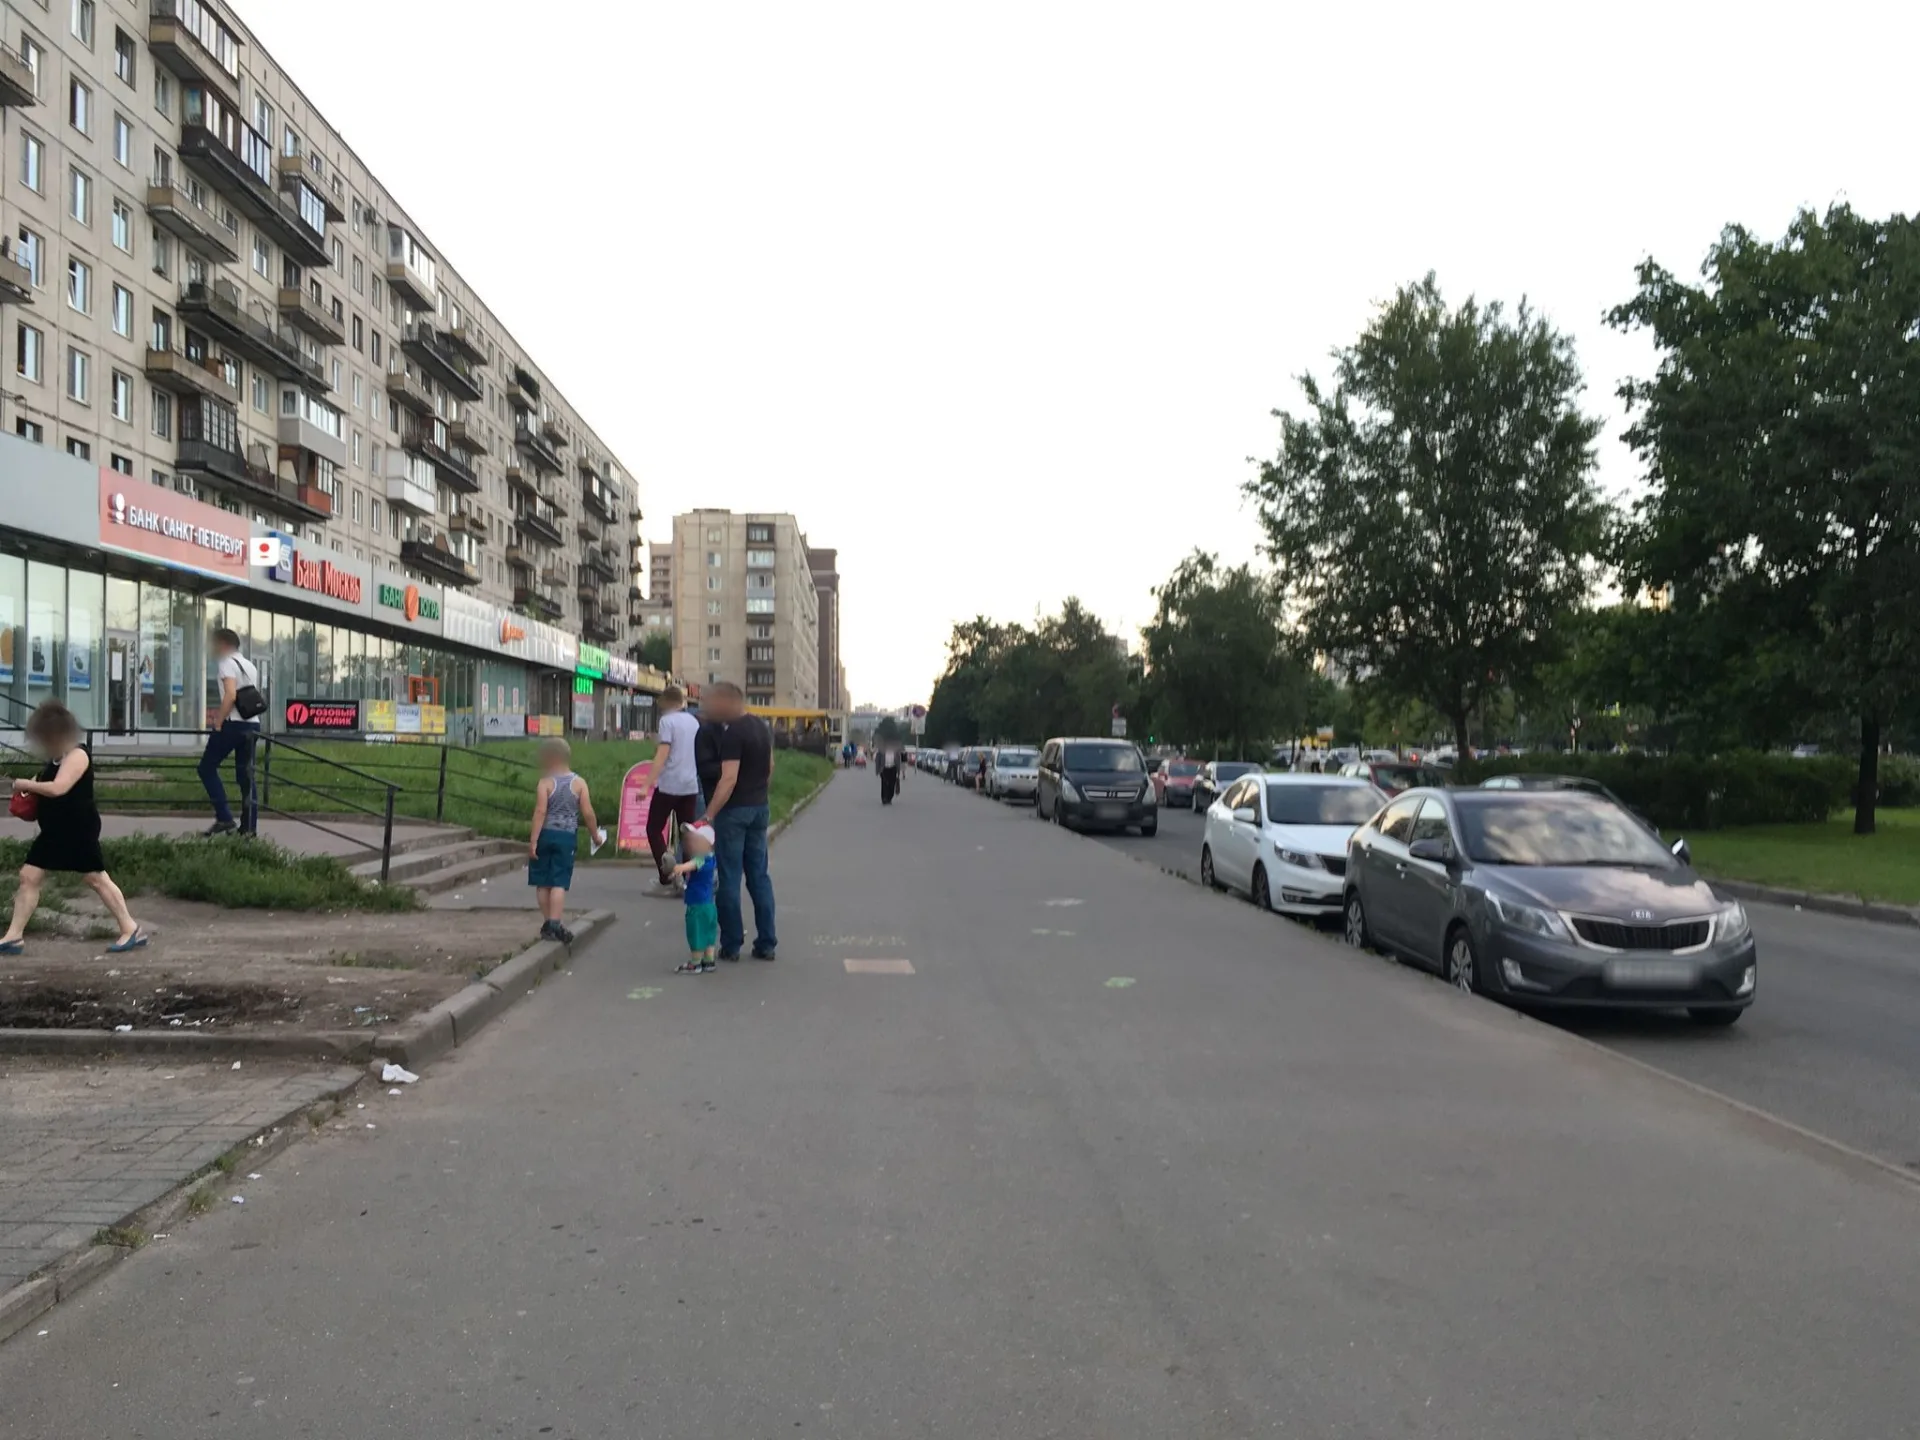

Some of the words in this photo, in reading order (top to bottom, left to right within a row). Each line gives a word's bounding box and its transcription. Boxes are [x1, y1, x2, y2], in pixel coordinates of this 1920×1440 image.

[130, 506, 160, 532] БАНК
[162, 516, 244, 557] САНКТ-ПЕТЕРБУРГ
[324, 560, 361, 605] Москвы
[309, 708, 356, 717] РОЗОВЫЙ
[313, 717, 352, 725] КРОЛИК
